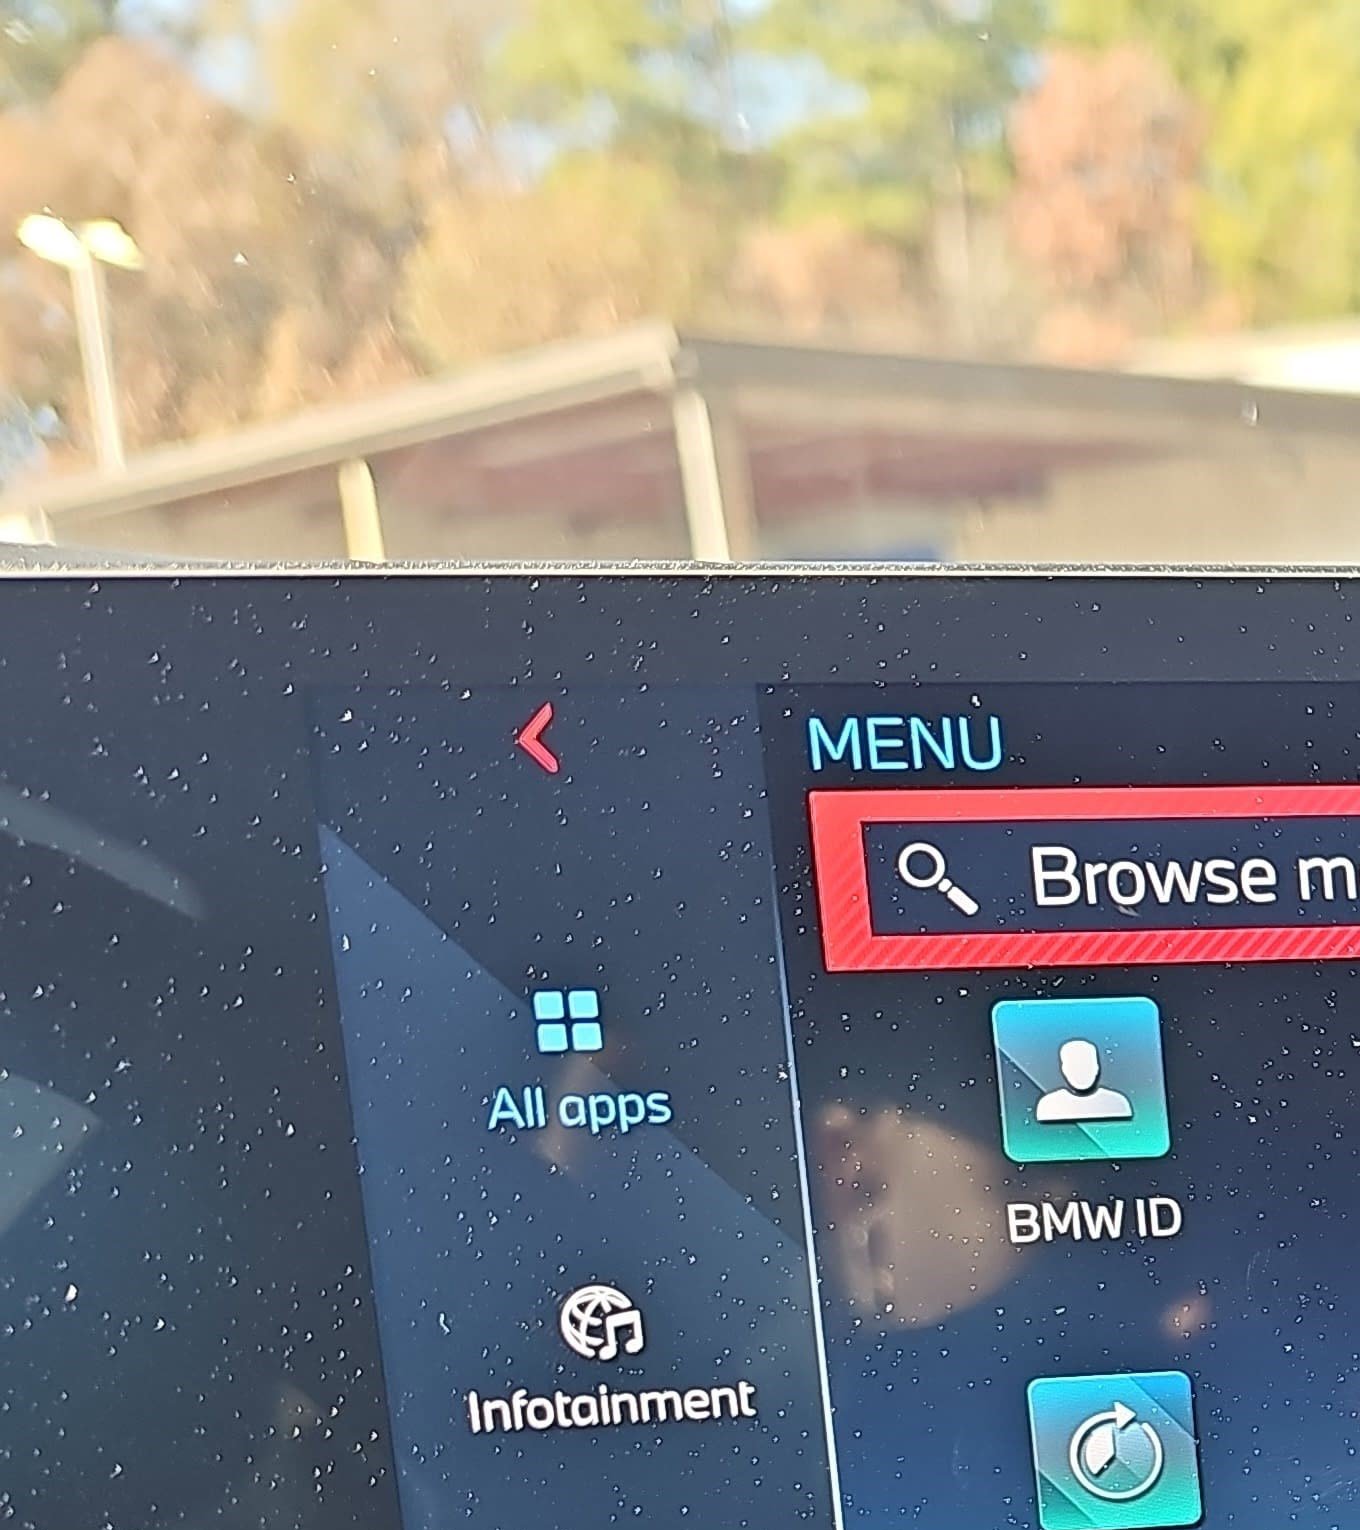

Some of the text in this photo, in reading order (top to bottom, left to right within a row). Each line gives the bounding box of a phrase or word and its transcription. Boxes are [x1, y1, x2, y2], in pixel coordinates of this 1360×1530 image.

[807, 714, 1004, 773] MENU
[1030, 845, 1277, 907] Browse
[487, 1086, 672, 1135] All apps
[1007, 1197, 1182, 1244] BMW ID
[467, 1381, 757, 1433] Infotainment
